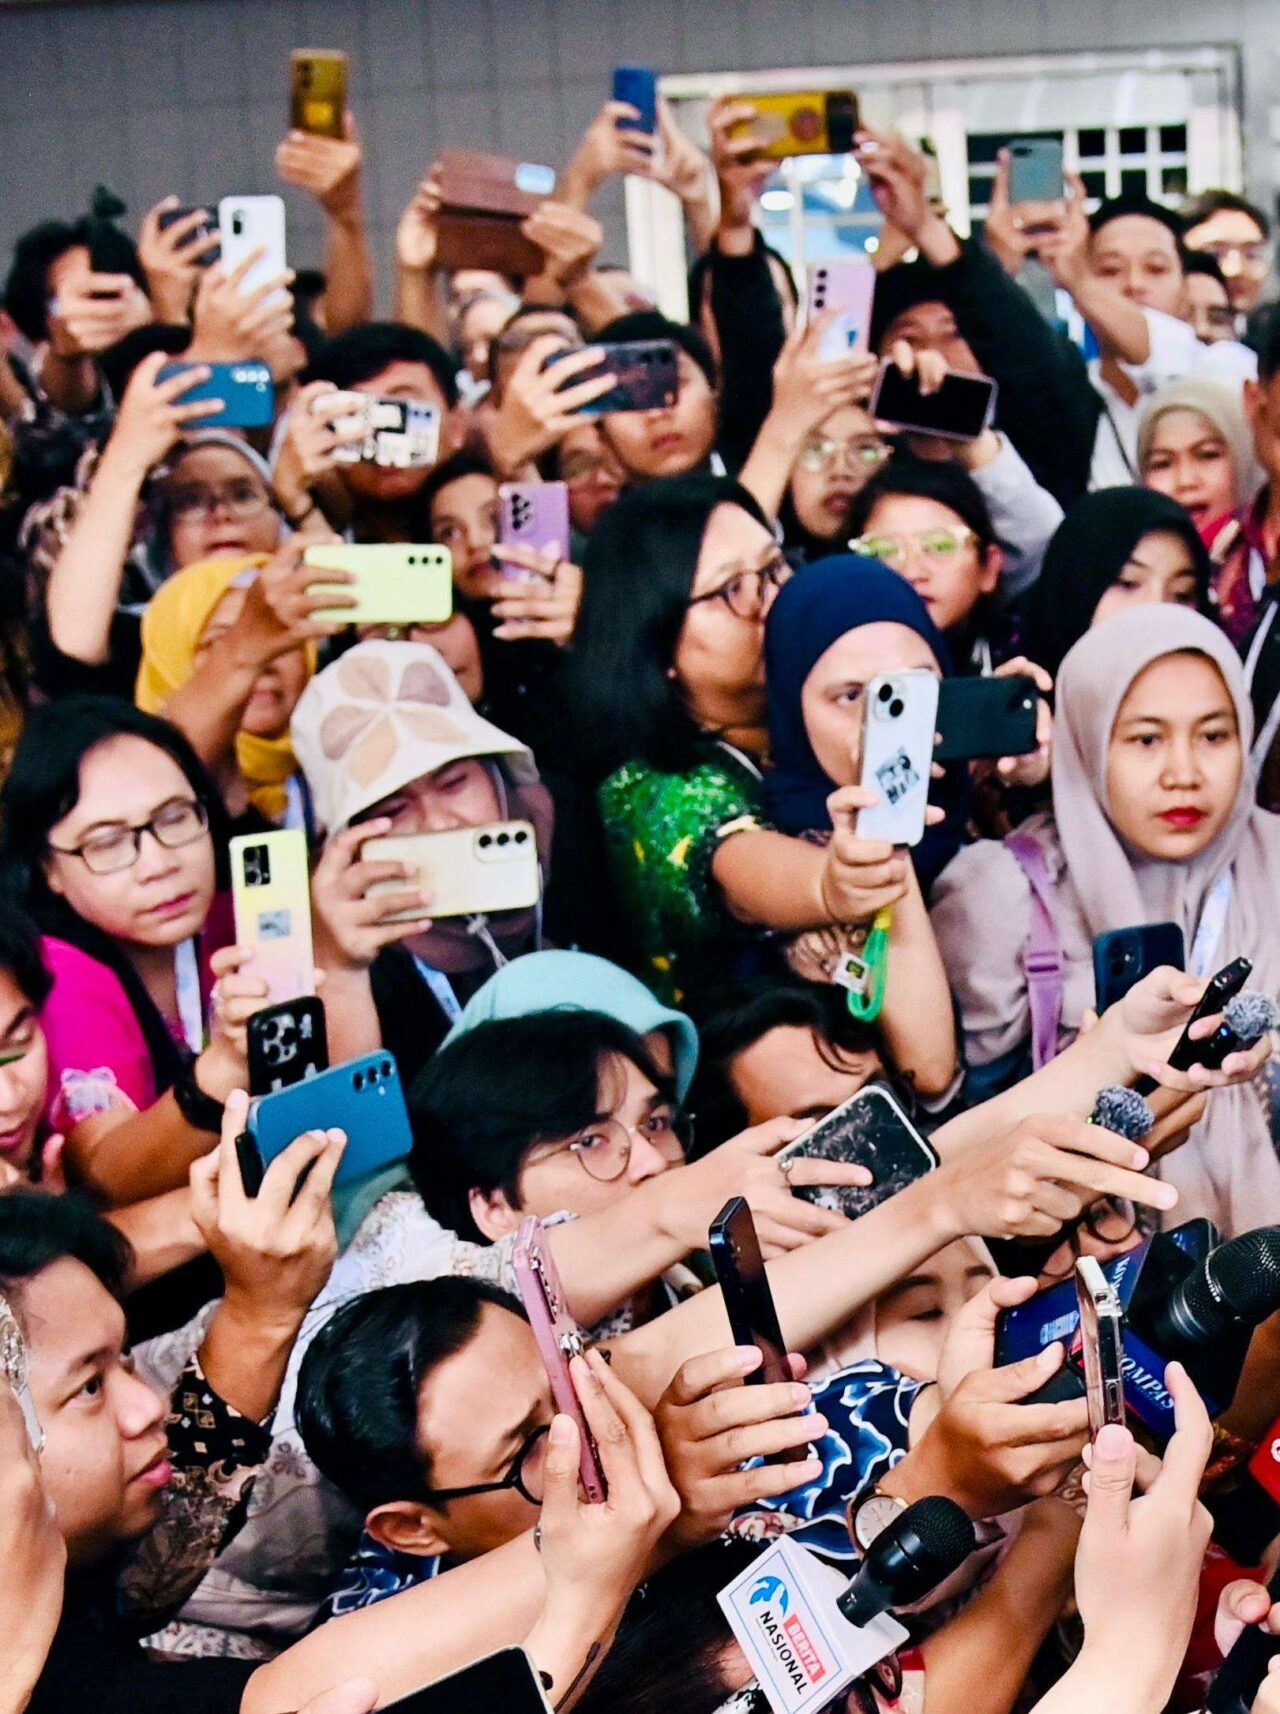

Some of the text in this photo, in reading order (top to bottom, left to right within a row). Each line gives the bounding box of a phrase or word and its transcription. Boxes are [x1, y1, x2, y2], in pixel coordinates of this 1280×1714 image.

[1120, 1354, 1174, 1410] OMPAS
[760, 1611, 809, 1695] NASIONAL
[787, 1622, 821, 1677] BERITA
